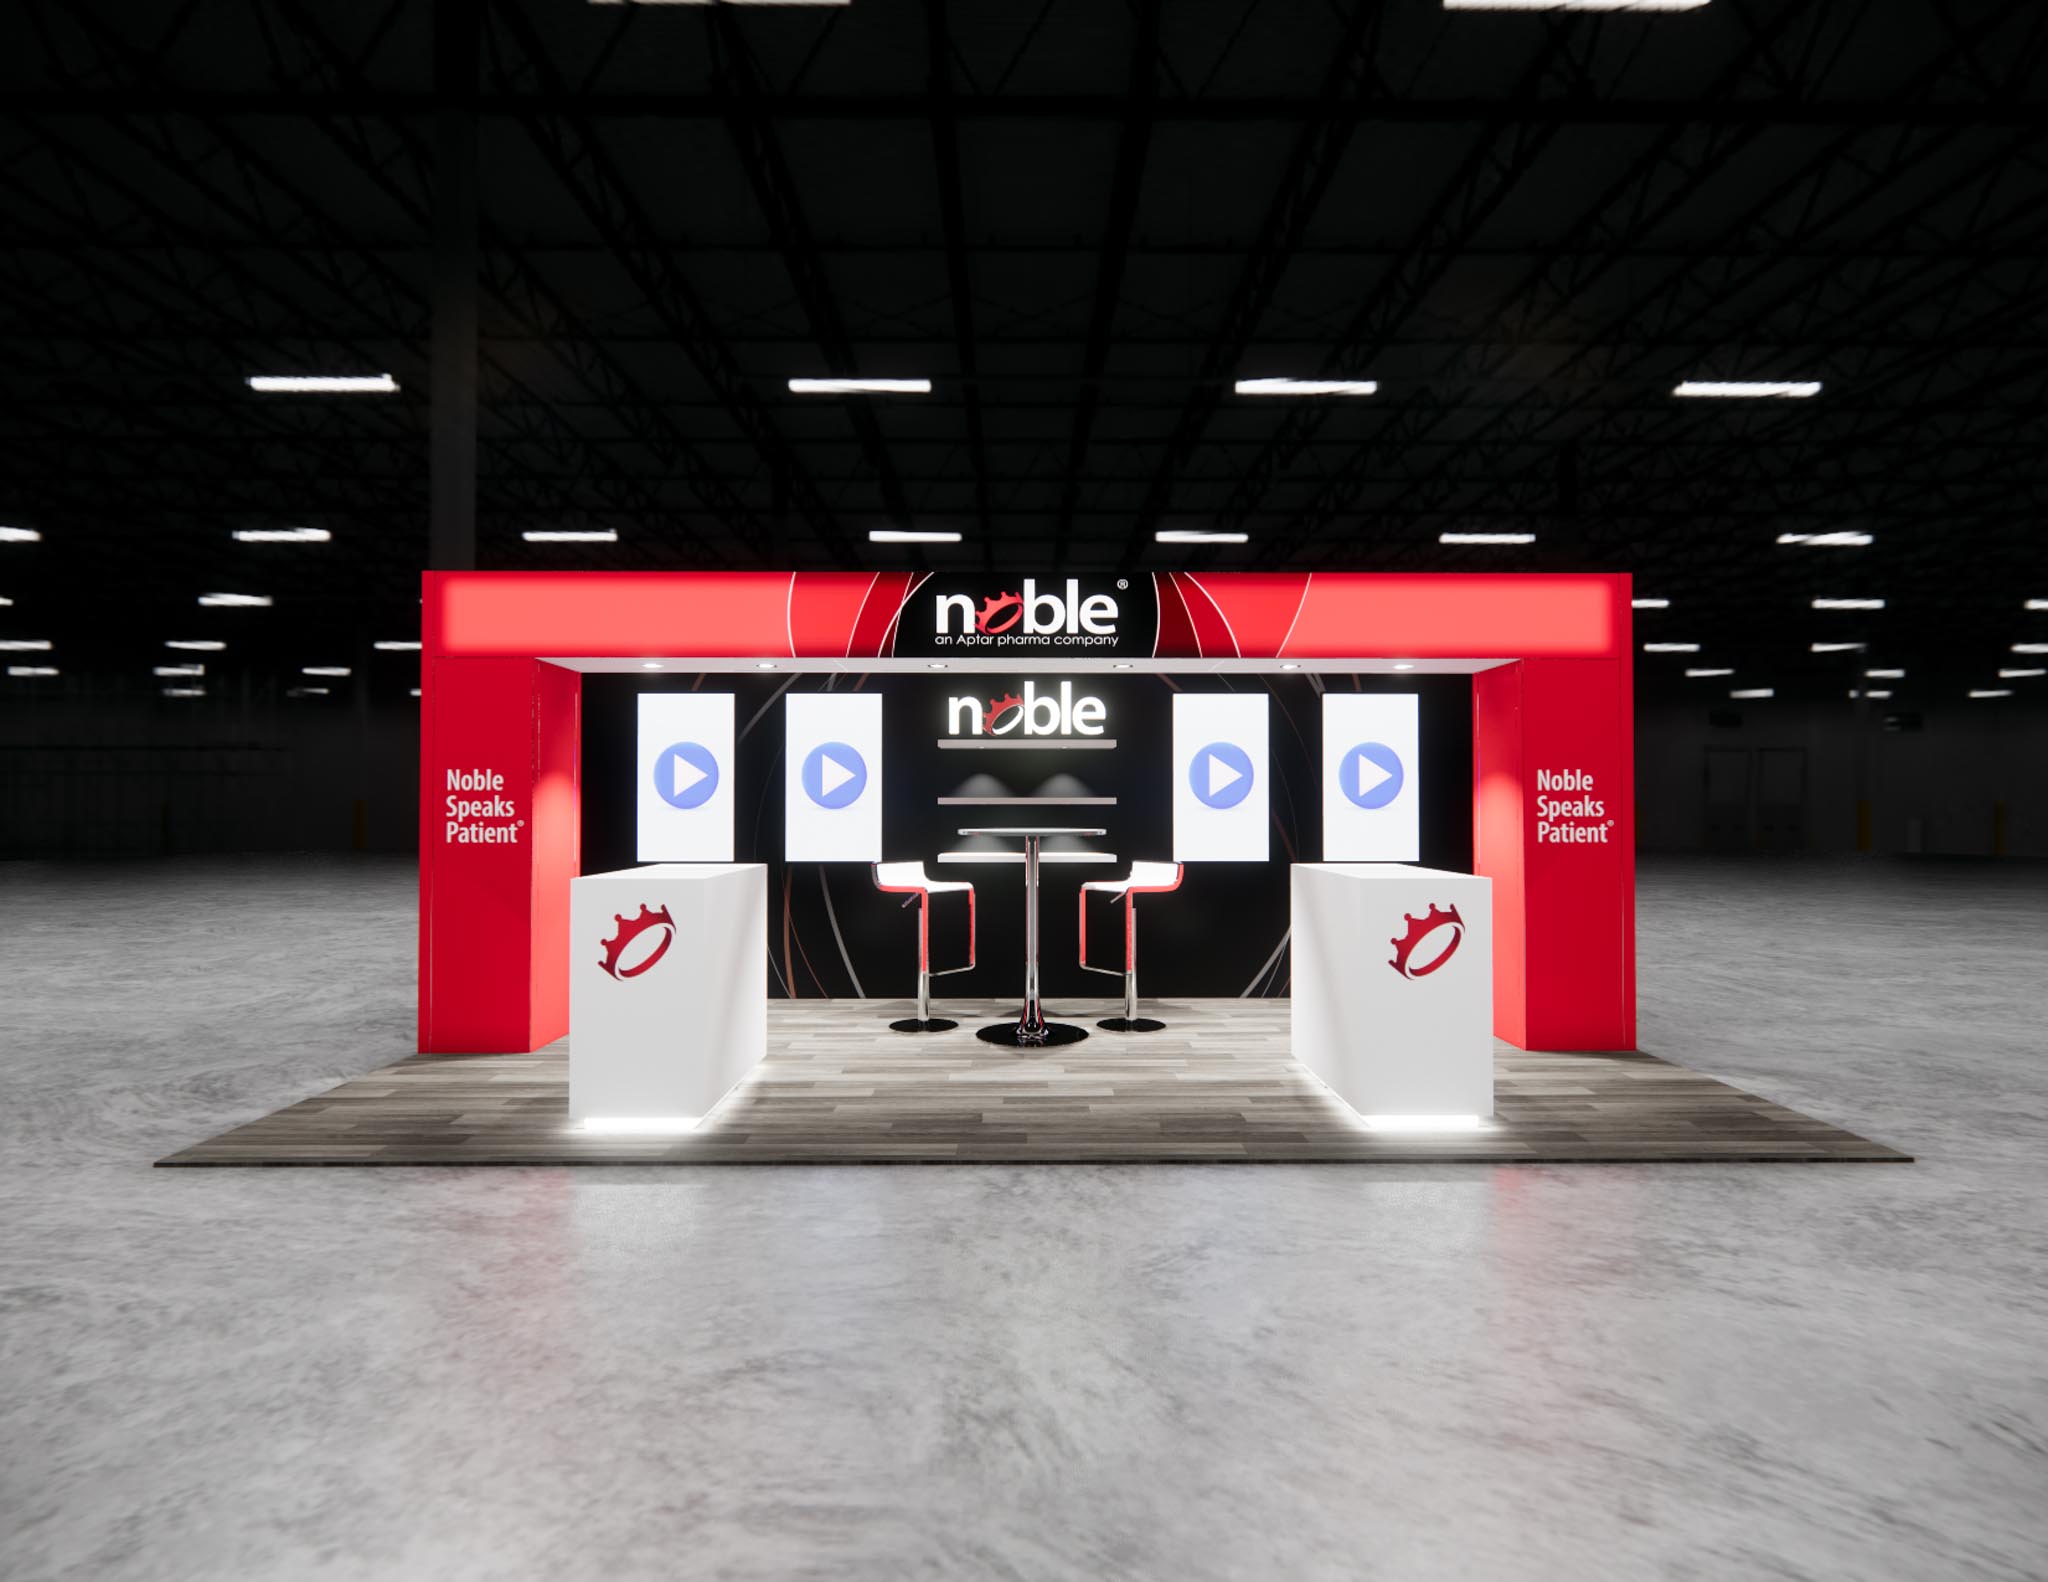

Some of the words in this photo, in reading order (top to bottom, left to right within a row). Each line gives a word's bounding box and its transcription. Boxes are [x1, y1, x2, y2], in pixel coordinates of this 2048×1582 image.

[934, 635, 953, 645] an
[956, 633, 995, 647] Aptar
[997, 633, 1051, 647] pharma
[1053, 635, 1120, 647] company
[948, 680, 1106, 736] noble
[446, 768, 505, 792] Noble
[1537, 768, 1595, 792] Noble
[445, 794, 516, 822] Speaks
[1536, 794, 1605, 822] Speaks
